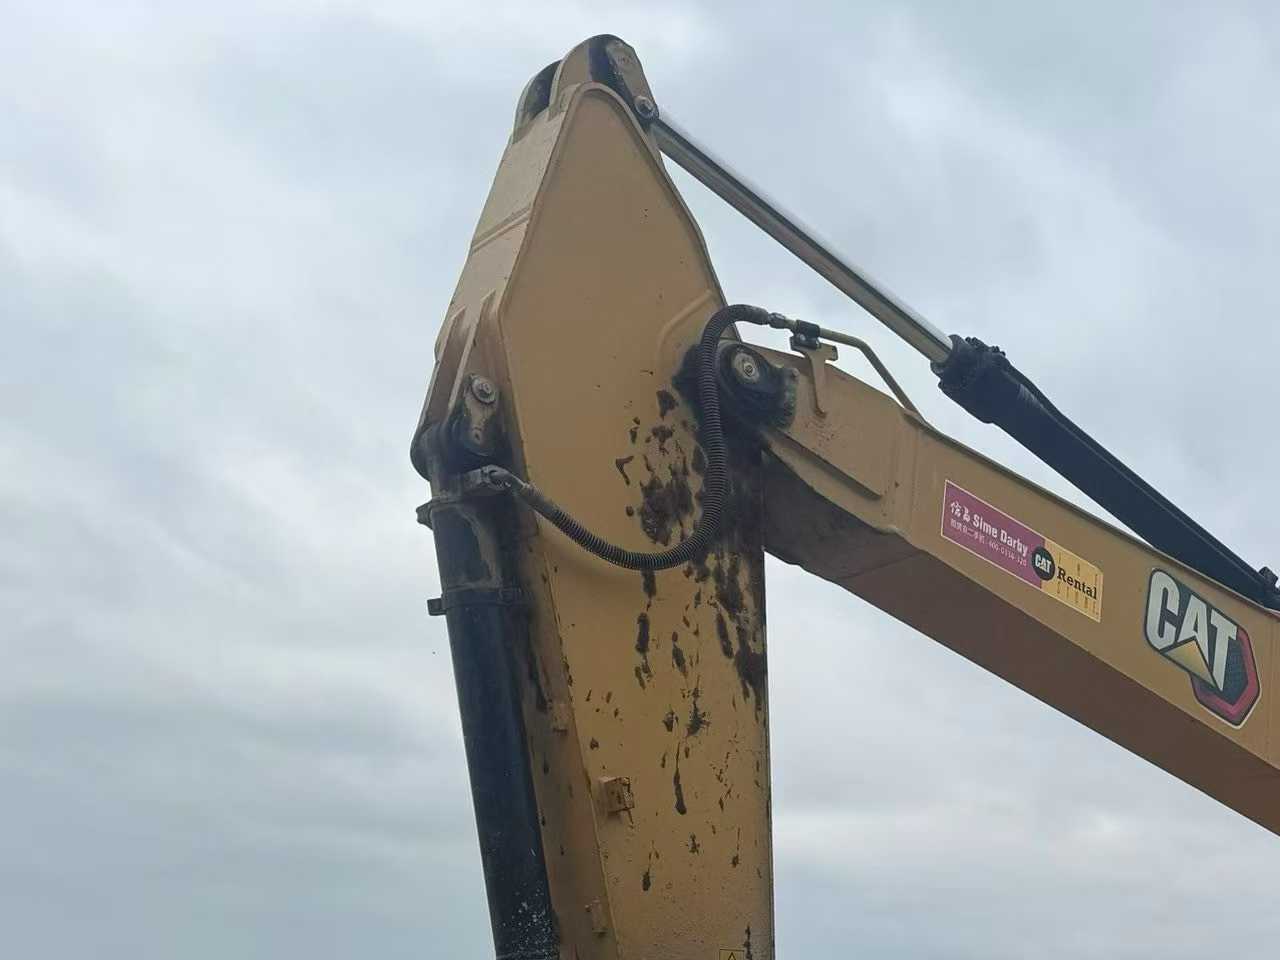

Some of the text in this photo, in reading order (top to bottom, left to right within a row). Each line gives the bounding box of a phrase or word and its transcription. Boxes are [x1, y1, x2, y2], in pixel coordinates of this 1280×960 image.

[972, 513, 998, 539] Sime
[1000, 528, 1028, 557] Darby
[1034, 553, 1098, 600] CAT Rental
[1147, 568, 1238, 692] CAT
